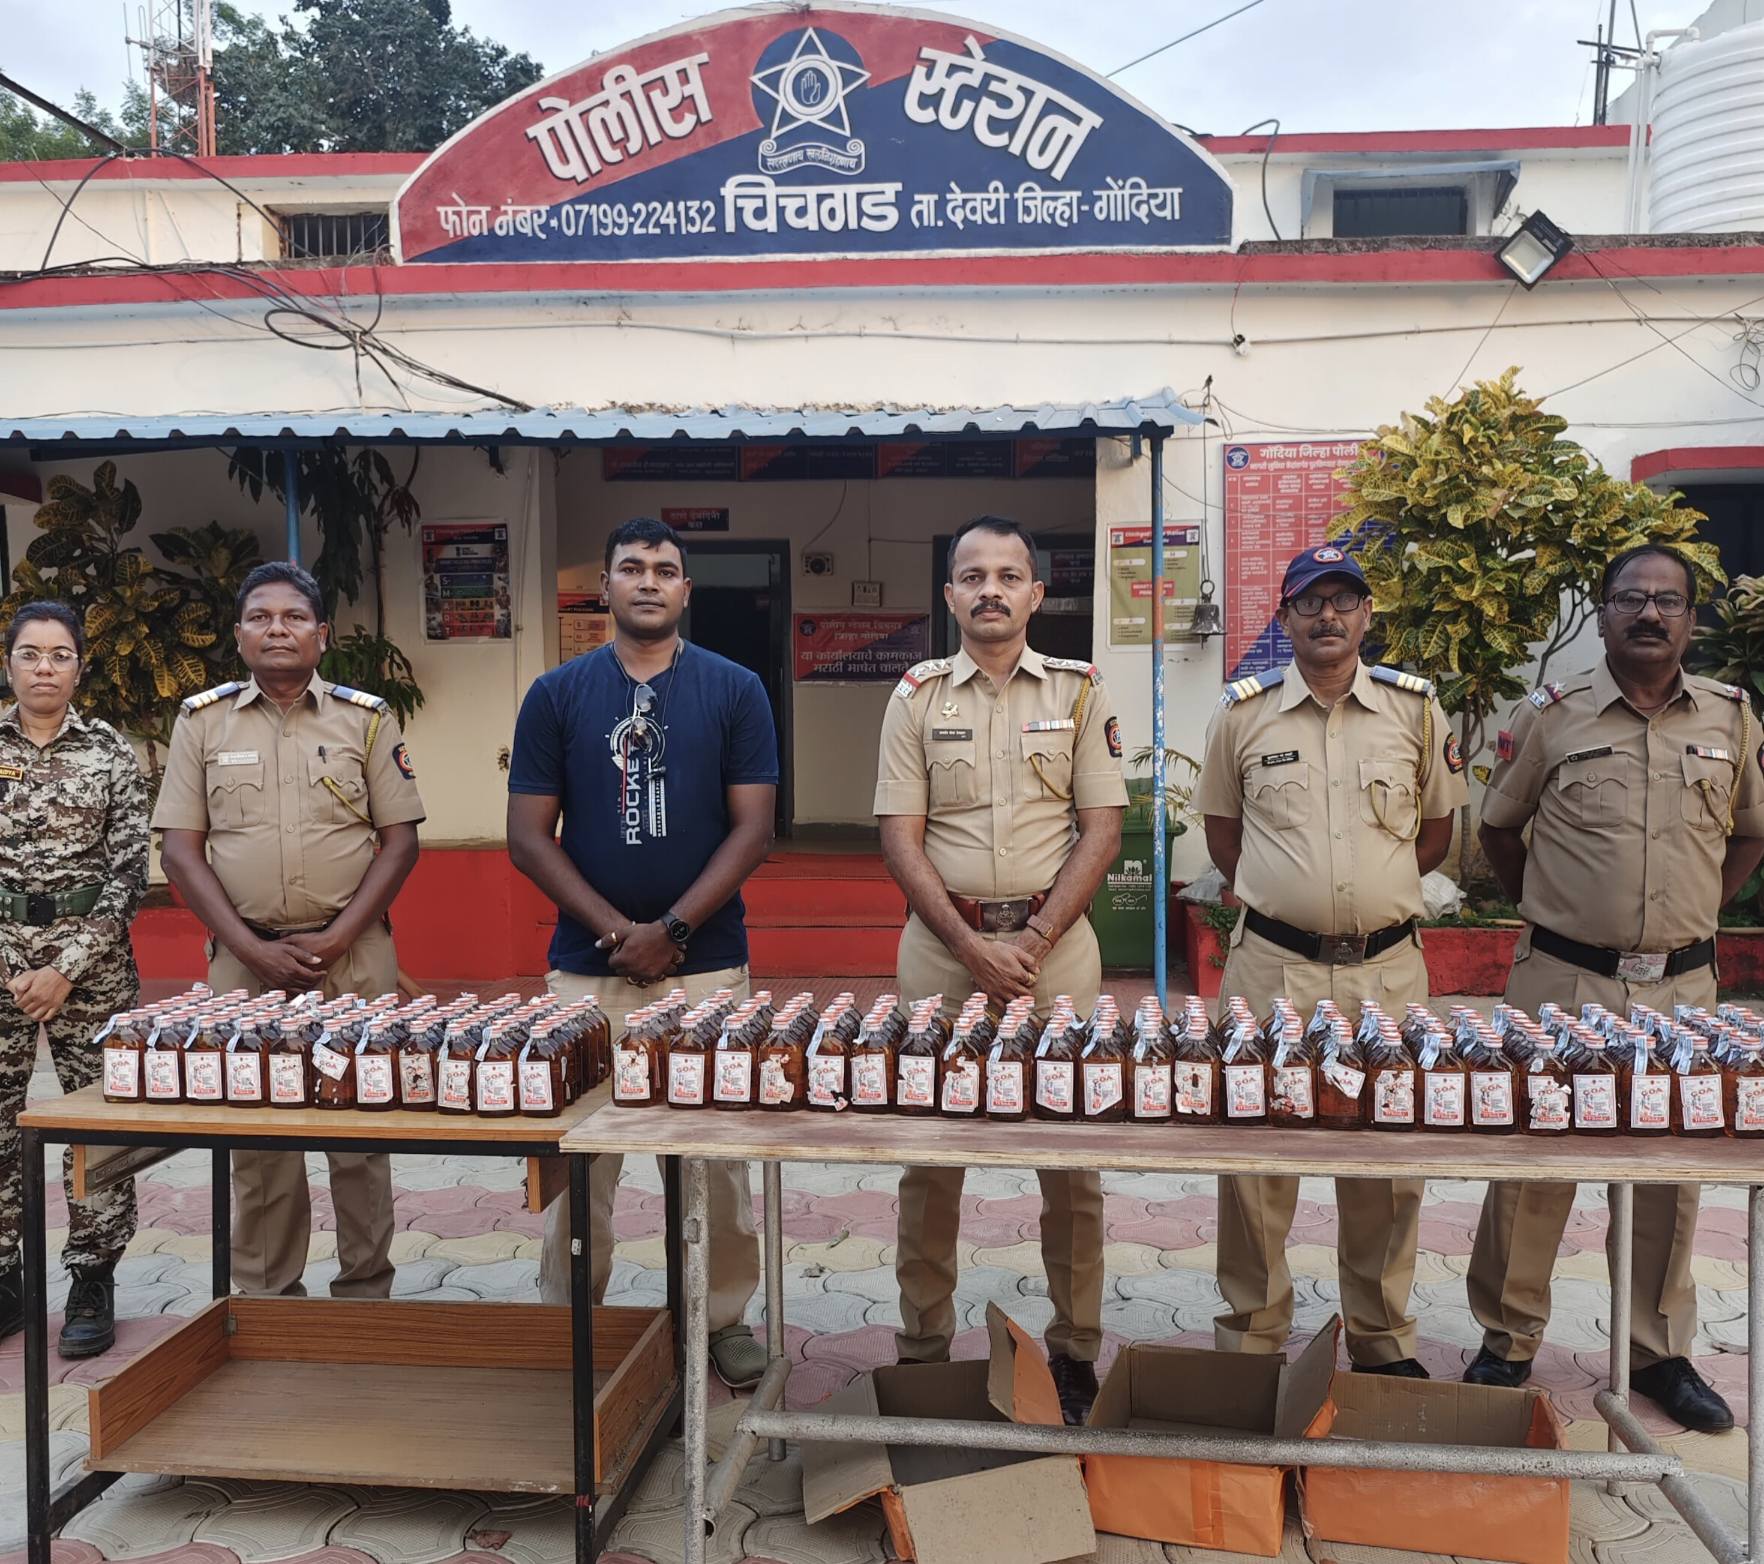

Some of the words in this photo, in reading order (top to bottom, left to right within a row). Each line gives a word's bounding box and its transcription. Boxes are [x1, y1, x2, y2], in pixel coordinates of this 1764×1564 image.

[526, 52, 710, 186] पोलीस
[903, 34, 1104, 182] स्टेशन
[436, 192, 491, 238] फोन
[720, 174, 902, 233] चिचगड
[1260, 444, 1297, 459] गोंदिया
[1299, 444, 1330, 458] जिल्हा
[1333, 443, 1360, 457] पोली
[800, 650, 813, 661] या
[875, 650, 922, 661] कामकाज
[814, 660, 843, 673] मराठी
[847, 661, 876, 673] भाषेत
[1107, 873, 1152, 882] Nilkamal
